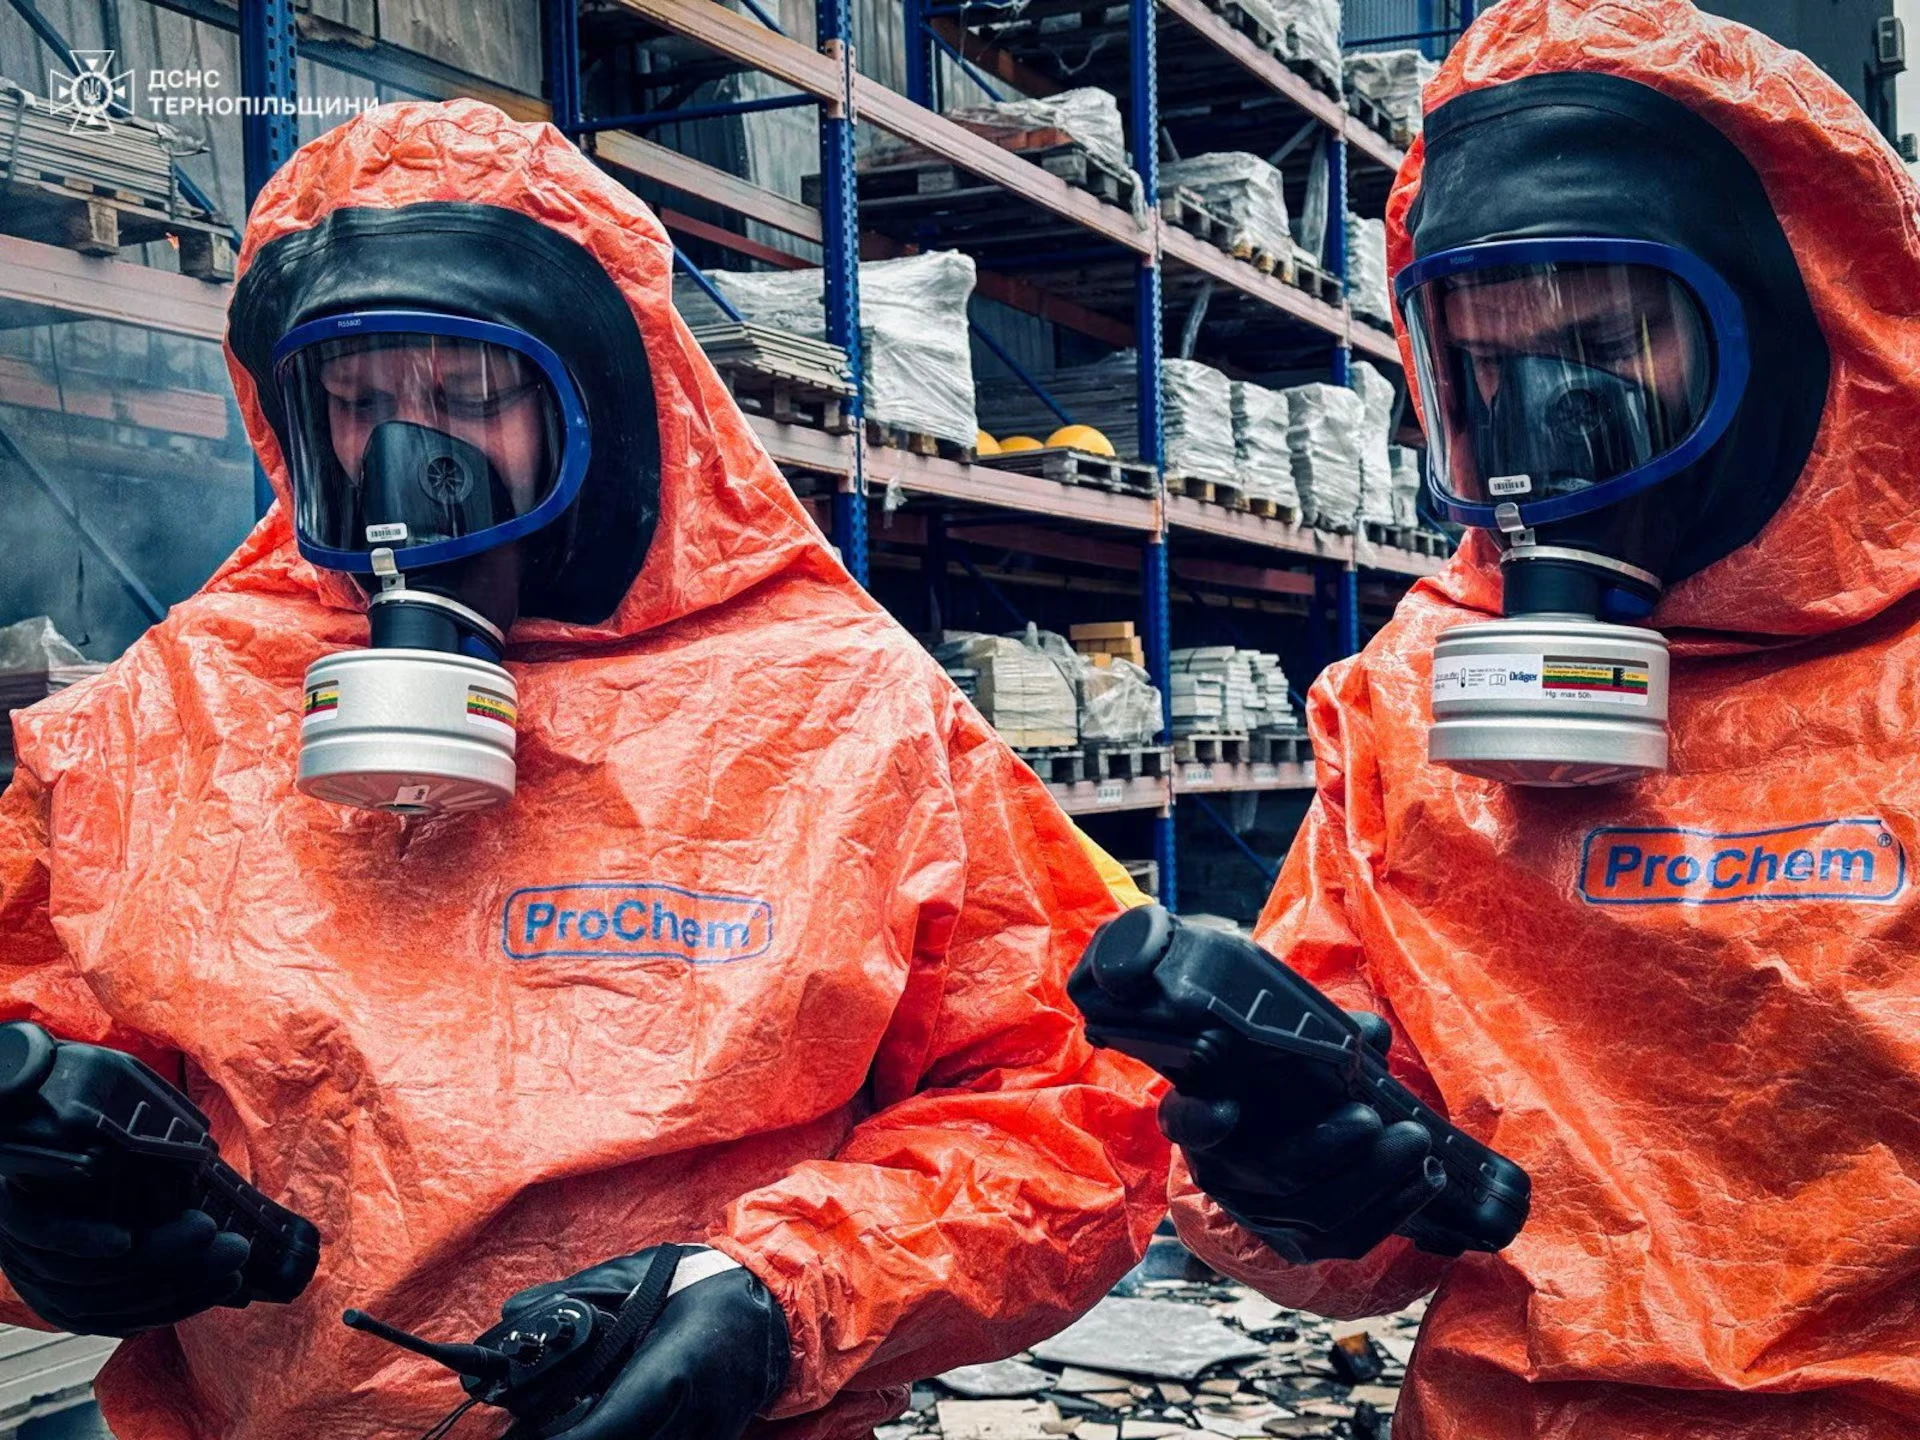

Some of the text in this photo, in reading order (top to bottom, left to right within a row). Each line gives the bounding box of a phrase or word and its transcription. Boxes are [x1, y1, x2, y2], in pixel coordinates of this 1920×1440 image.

[1509, 671, 1537, 683] Dräger
[1604, 845, 1874, 889] ProChem
[525, 899, 750, 949] ProChem
